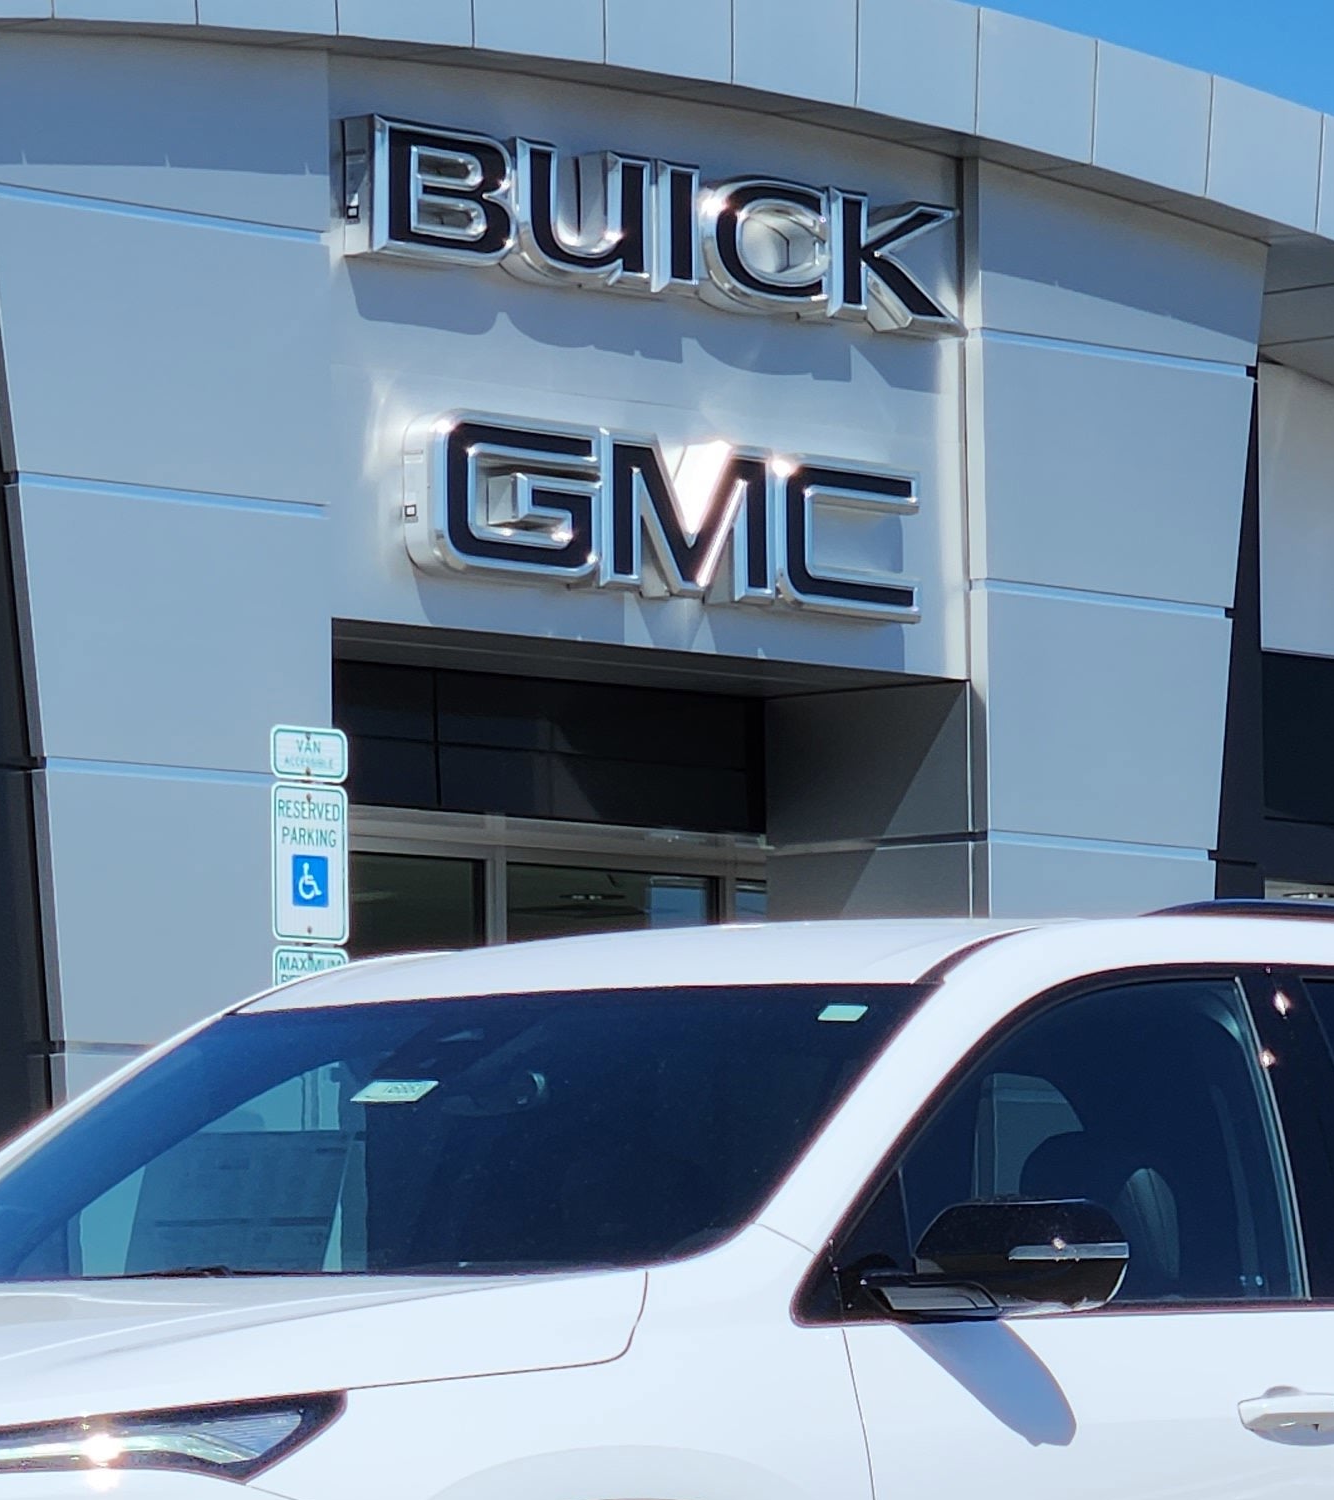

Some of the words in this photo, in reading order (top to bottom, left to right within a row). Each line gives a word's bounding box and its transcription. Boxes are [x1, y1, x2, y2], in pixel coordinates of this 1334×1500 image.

[367, 112, 965, 338] BUICK
[435, 408, 921, 623] GMC
[295, 739, 322, 754] VAN
[278, 799, 341, 823] RESERVED
[281, 826, 337, 848] PARKING
